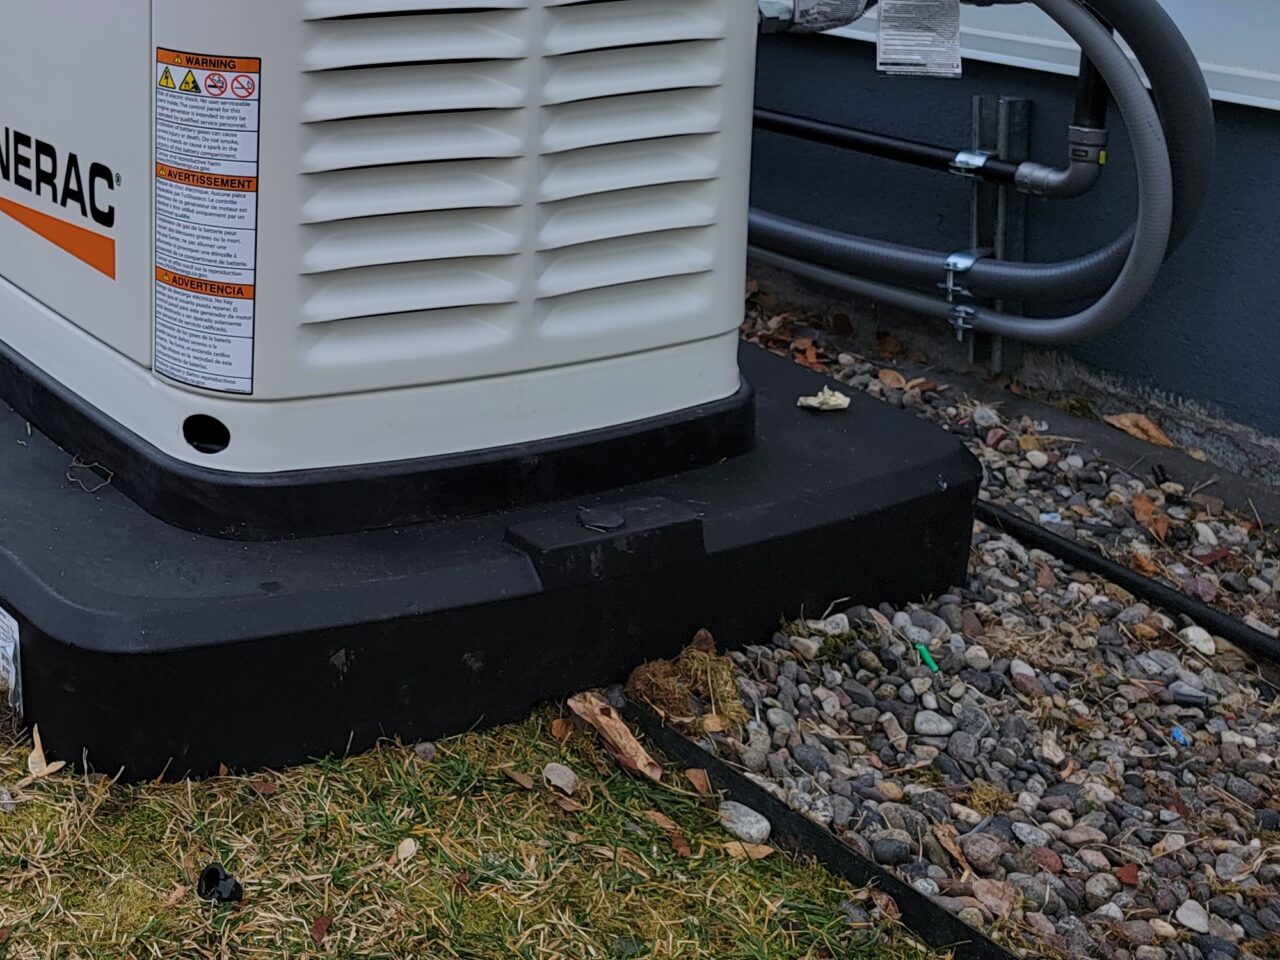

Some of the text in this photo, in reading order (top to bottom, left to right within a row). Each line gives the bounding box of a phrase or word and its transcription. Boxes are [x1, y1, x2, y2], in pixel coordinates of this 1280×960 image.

[185, 55, 236, 70] WARNING
[206, 105, 221, 113] panel
[167, 169, 252, 189] AVERTISSEMENT
[172, 276, 244, 296] ADVERTENCIA
